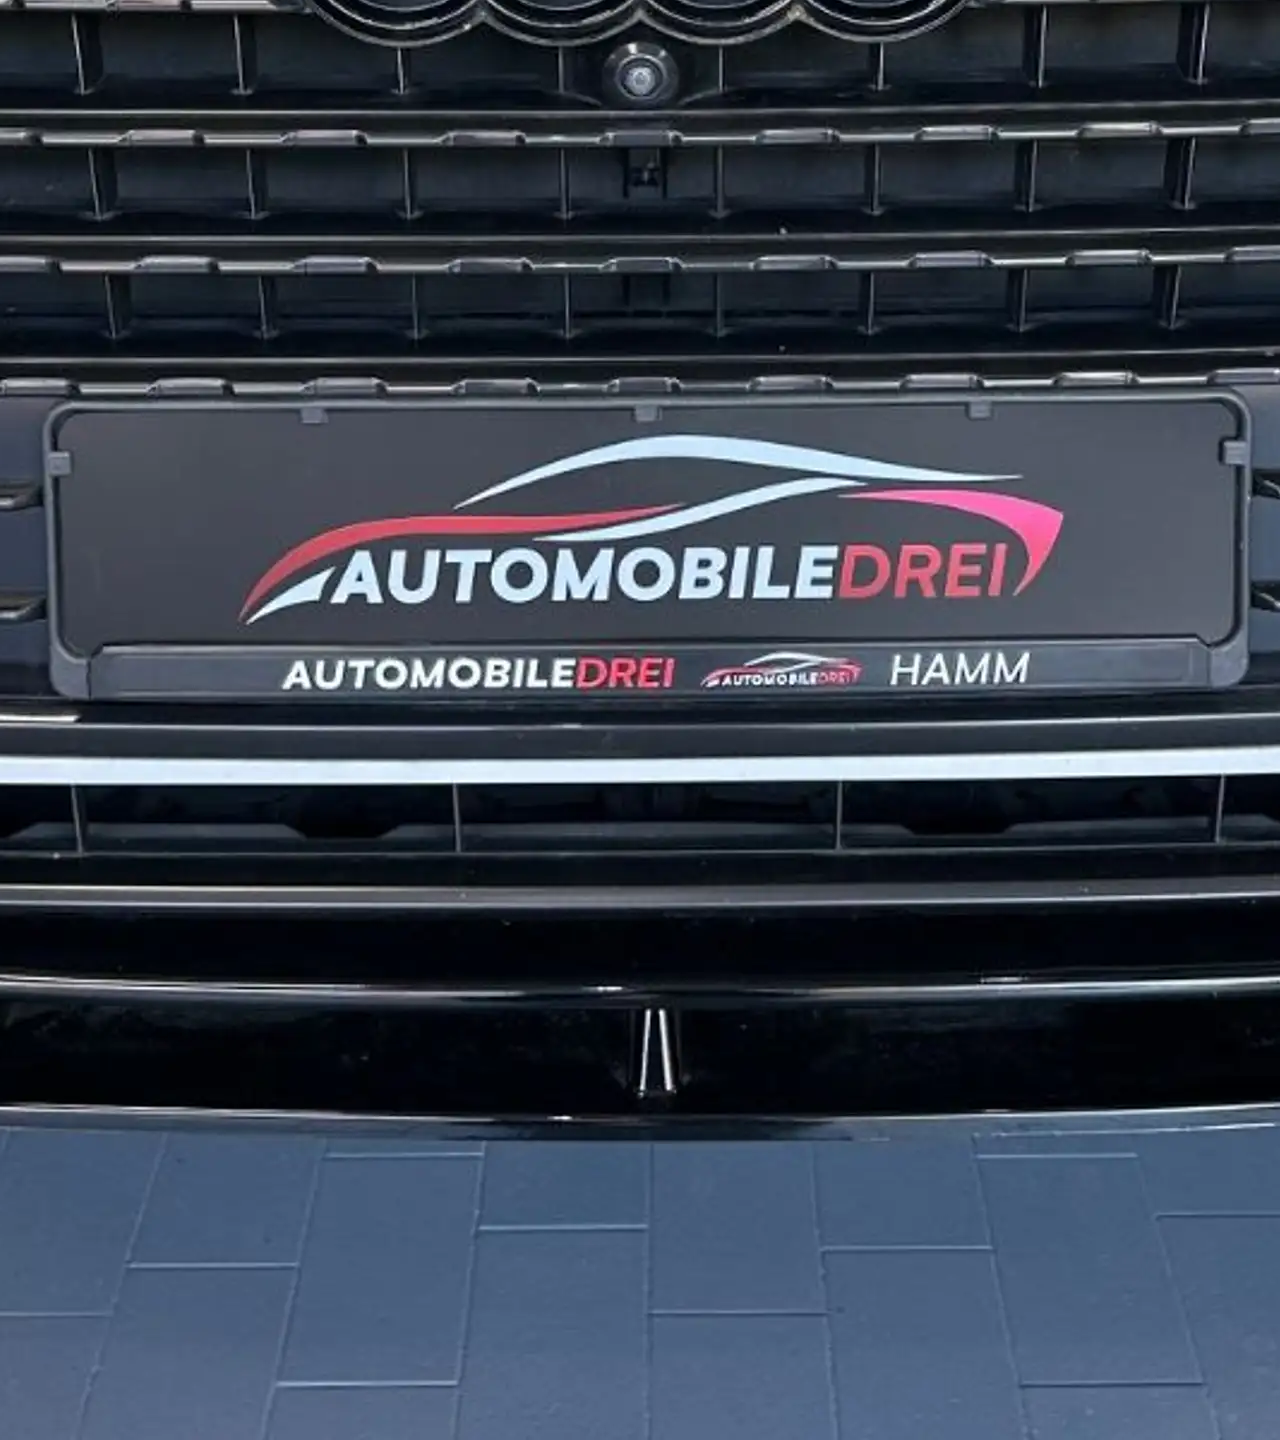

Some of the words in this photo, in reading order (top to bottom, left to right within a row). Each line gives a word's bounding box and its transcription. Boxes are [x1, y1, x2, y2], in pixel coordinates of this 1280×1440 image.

[329, 543, 1010, 605] AUTOMOBILEDREI
[282, 656, 677, 691] AUTOMOBILEDREI
[889, 651, 1031, 686] HAMM
